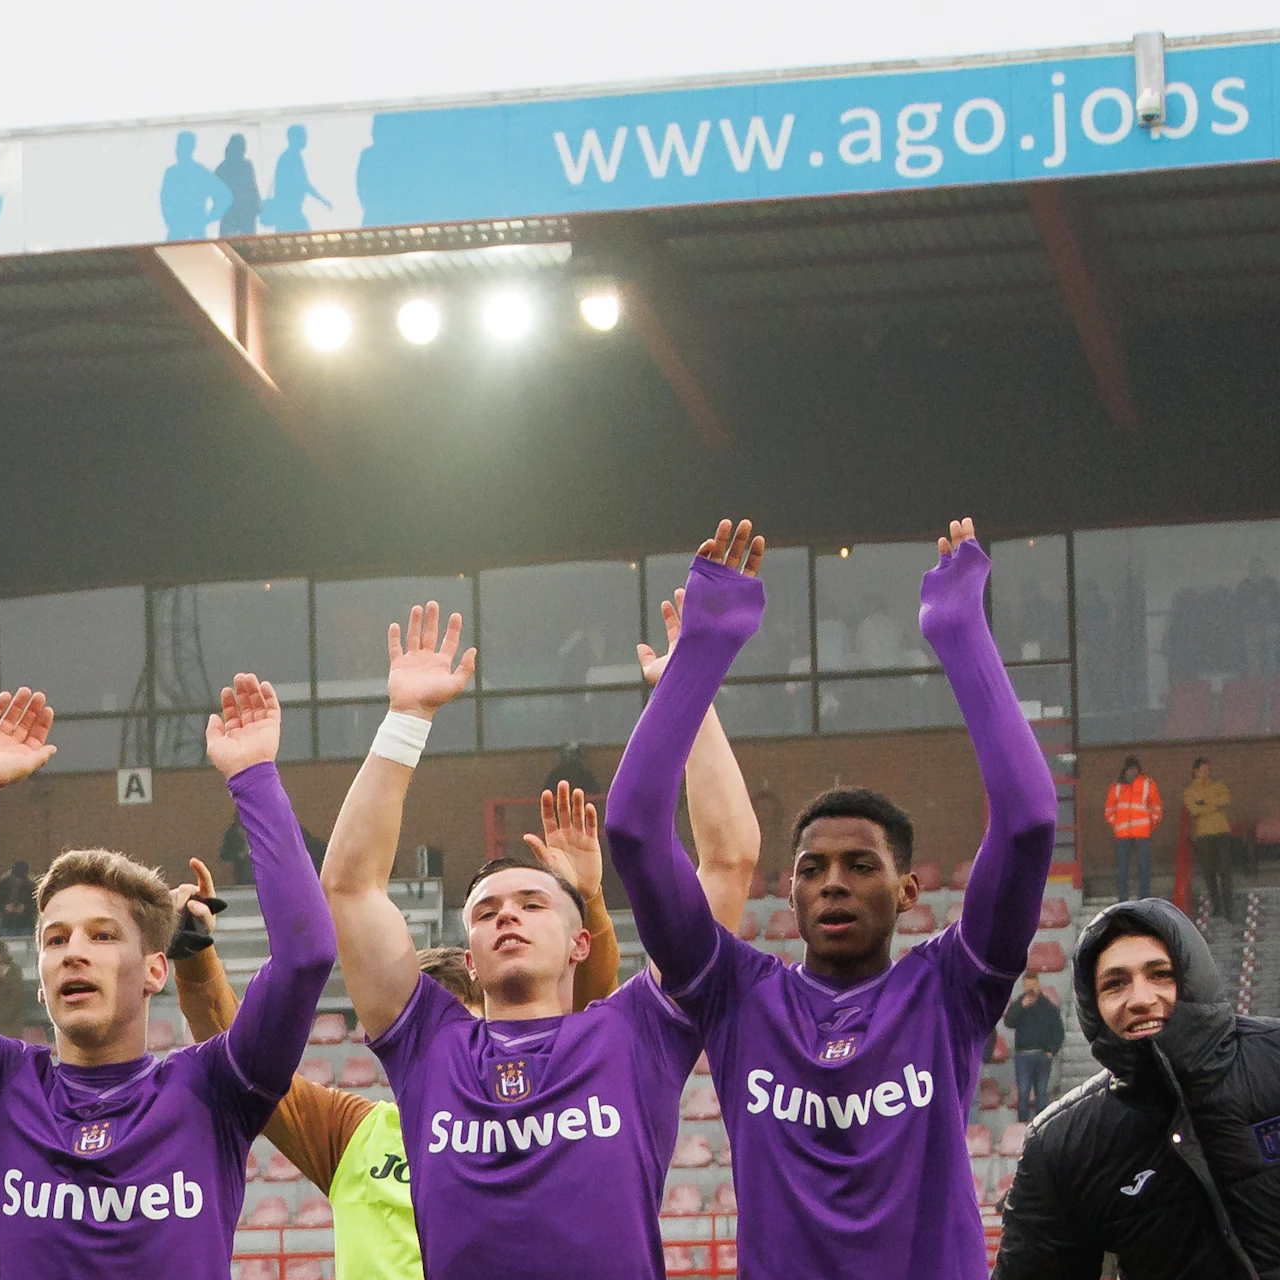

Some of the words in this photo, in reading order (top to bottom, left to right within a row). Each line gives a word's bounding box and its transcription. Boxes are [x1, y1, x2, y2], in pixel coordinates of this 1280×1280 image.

[553, 72, 1250, 186] www.ago.jobs
[125, 774, 146, 798] A
[427, 1096, 621, 1155] Sunweb
[746, 1064, 934, 1130] Sunweb
[1, 1168, 204, 1221] Sunweb
